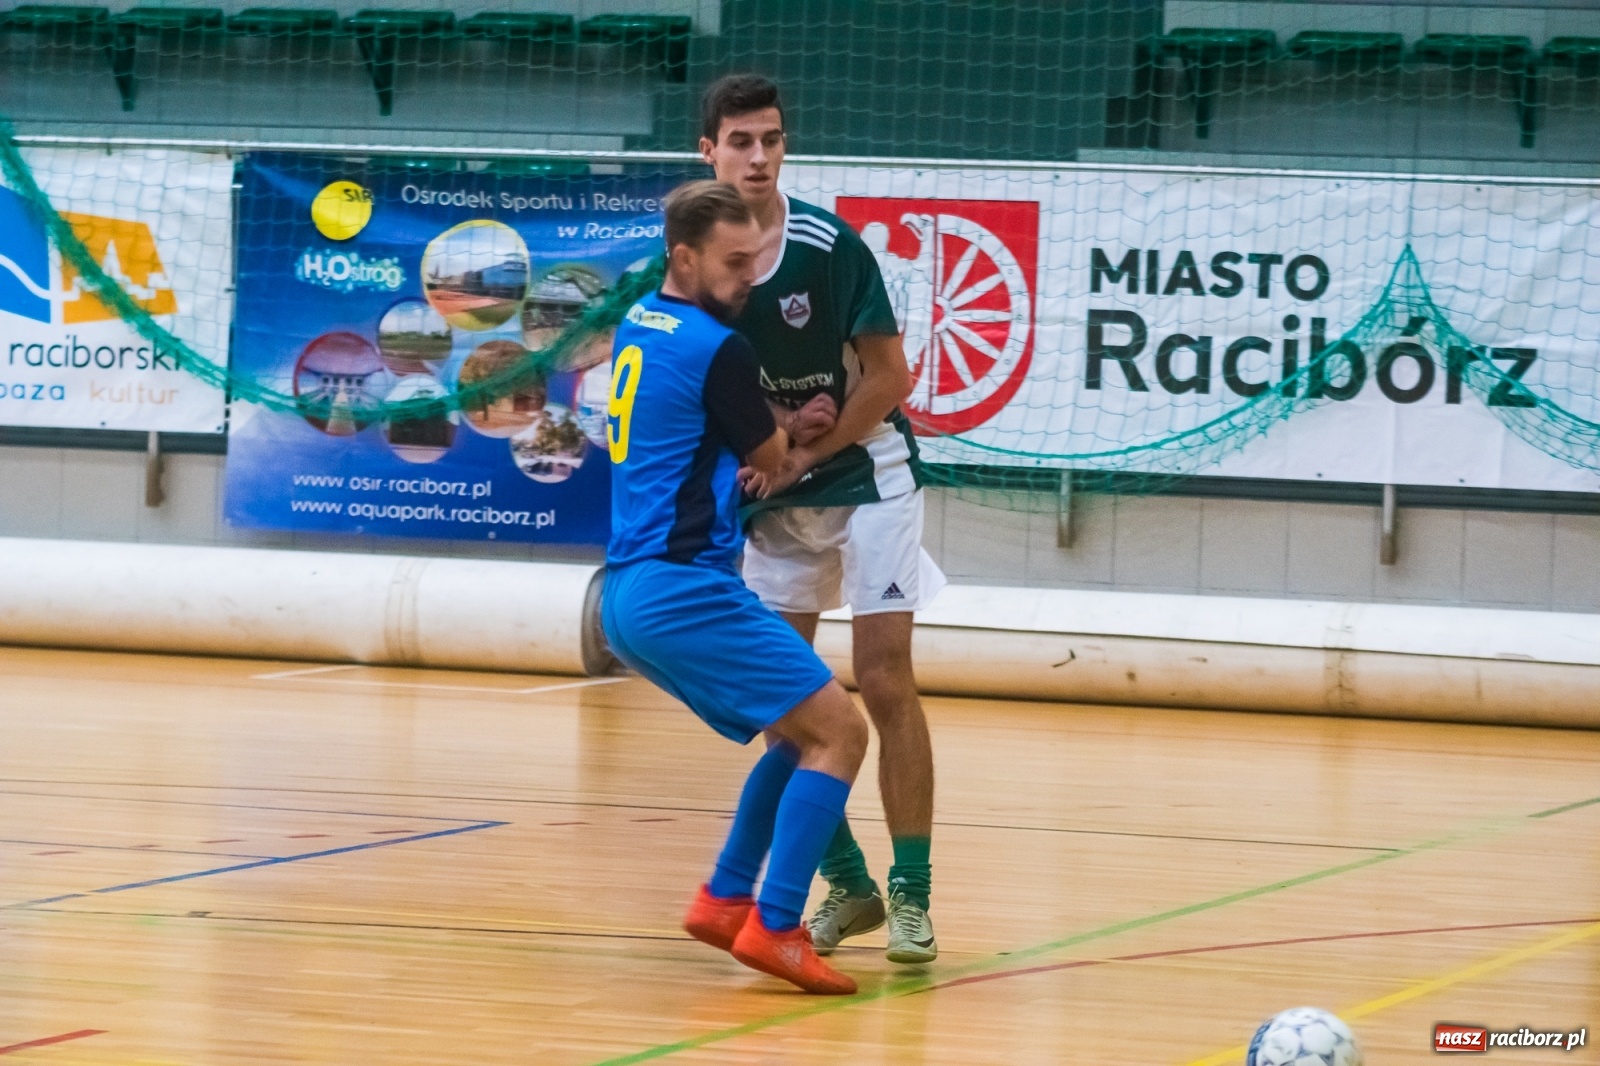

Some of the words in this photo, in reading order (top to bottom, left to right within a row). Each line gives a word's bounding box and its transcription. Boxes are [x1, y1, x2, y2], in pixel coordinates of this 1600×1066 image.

[500, 192, 573, 213] Sportu
[579, 193, 587, 211] i
[557, 226, 580, 239] w
[1089, 247, 1330, 301] MIASTO
[9, 334, 182, 371] raciborski
[1084, 308, 1538, 408] Racibórz
[89, 380, 180, 404] kultur
[607, 344, 644, 464] 9
